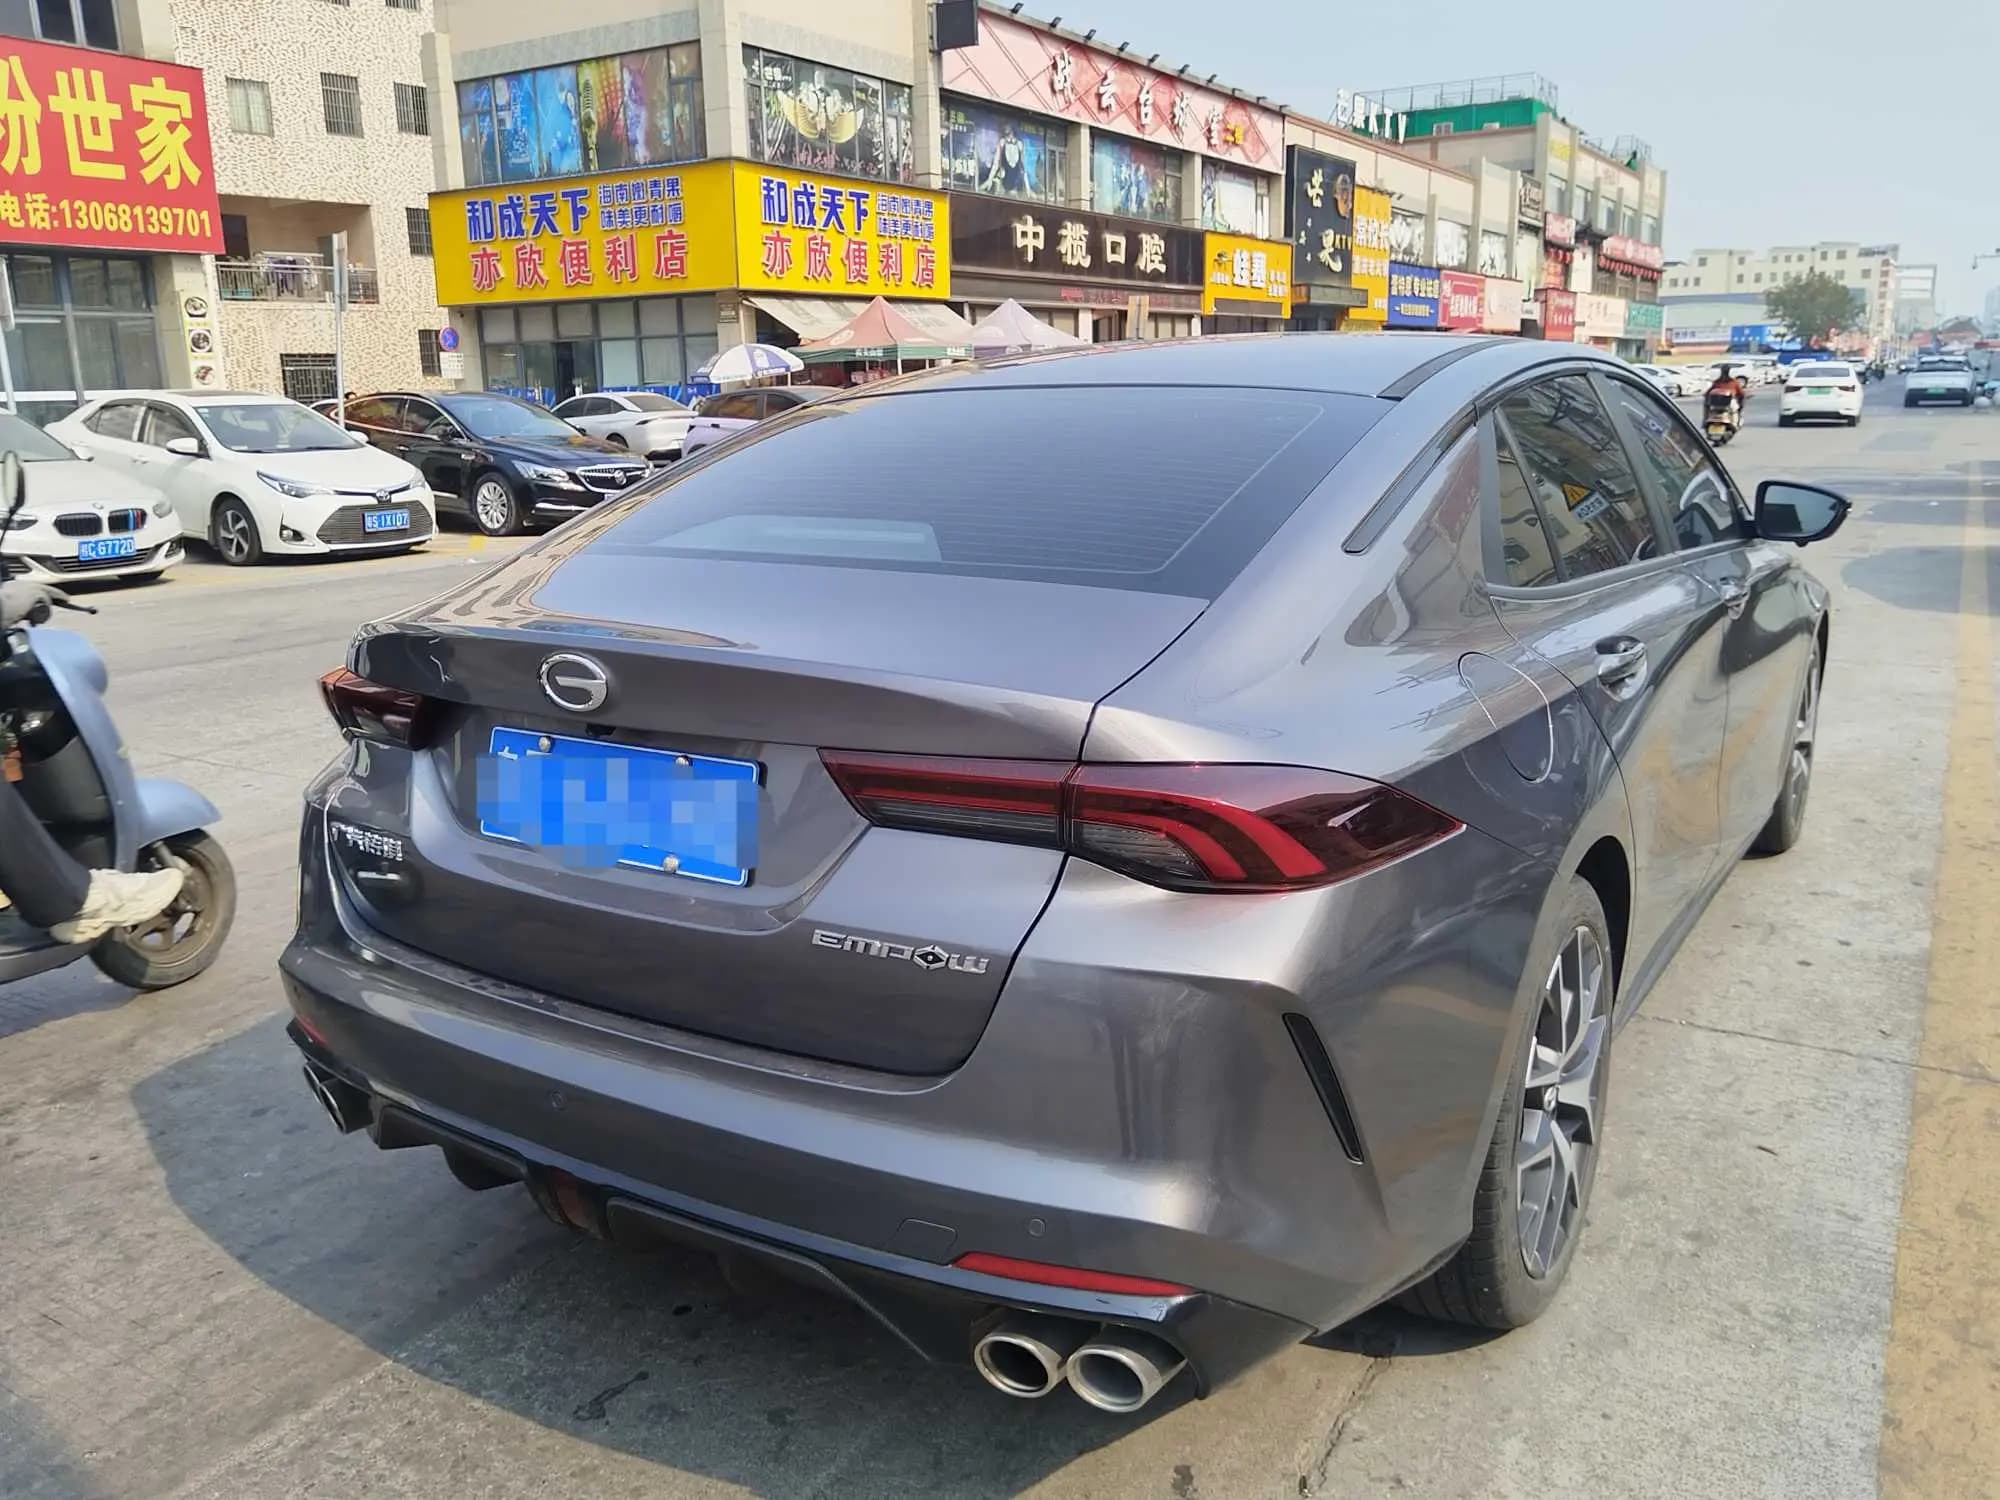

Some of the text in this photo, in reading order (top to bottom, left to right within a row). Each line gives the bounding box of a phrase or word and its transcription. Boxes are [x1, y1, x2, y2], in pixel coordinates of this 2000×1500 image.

[466, 187, 590, 243] 和成天下
[761, 176, 870, 233] 和成天下
[470, 229, 689, 291] 亦欣便利店
[762, 230, 936, 288] 亦欣便利店
[1011, 214, 1167, 274] 中榄口腔
